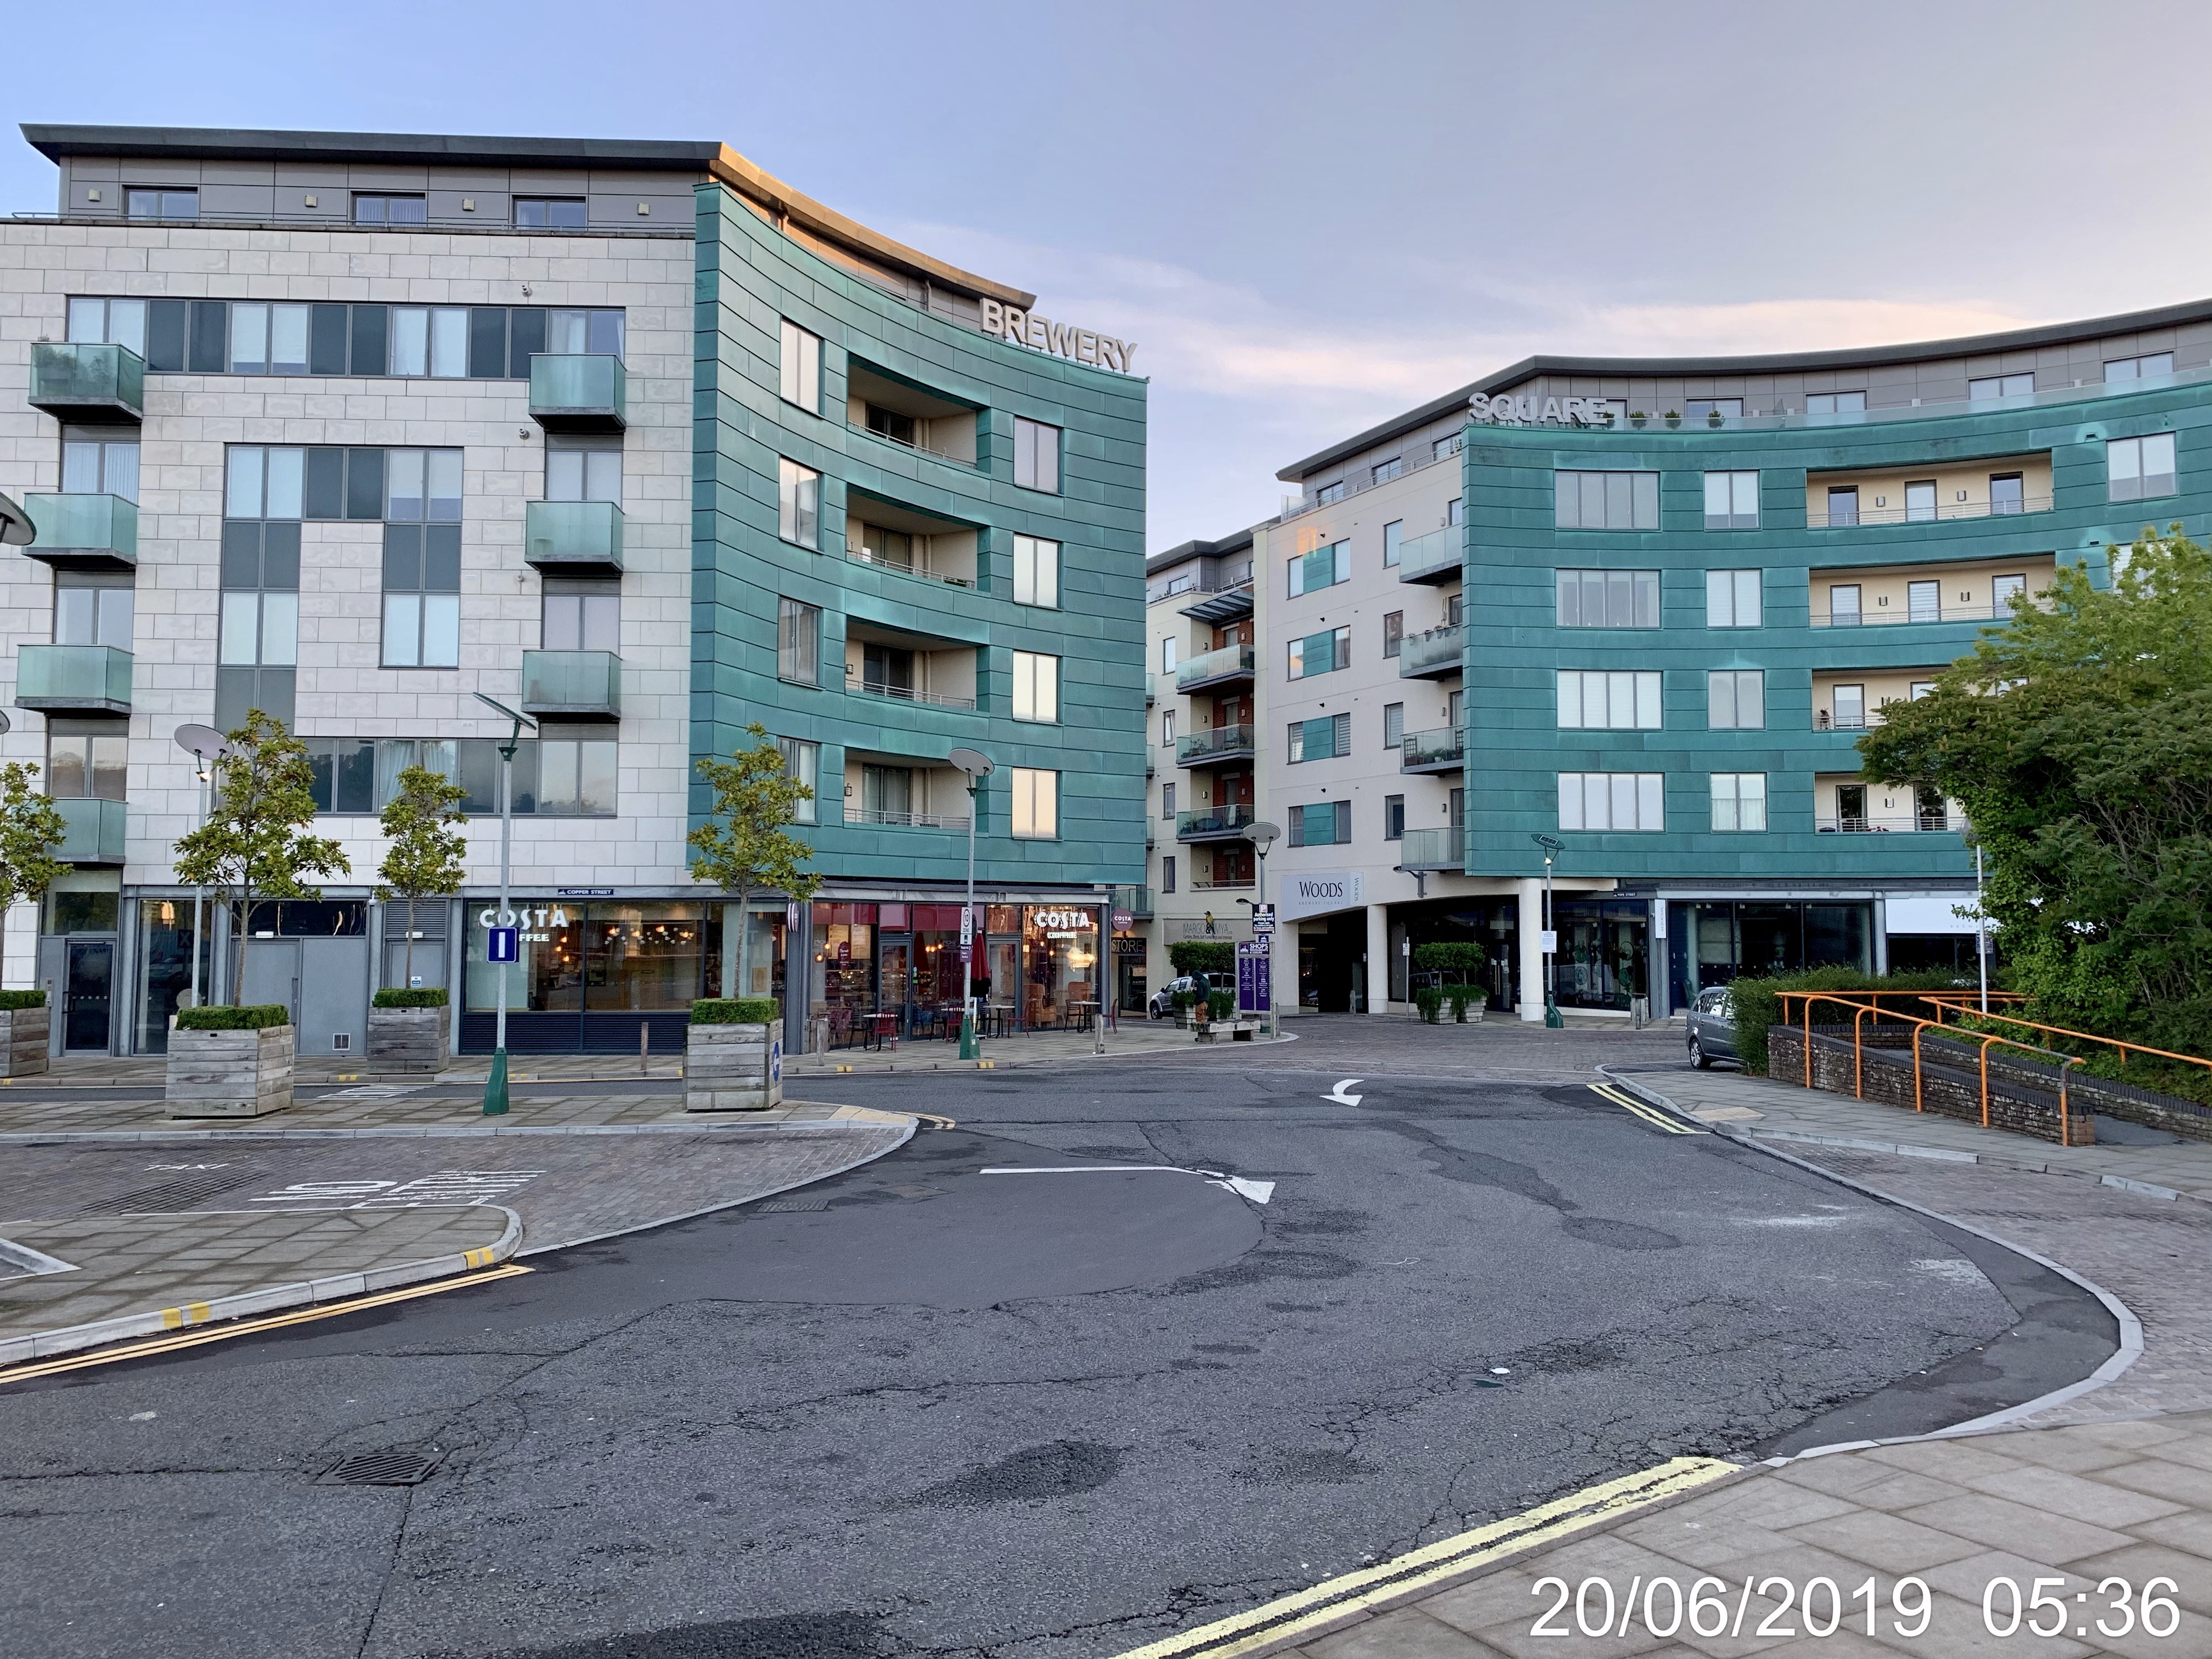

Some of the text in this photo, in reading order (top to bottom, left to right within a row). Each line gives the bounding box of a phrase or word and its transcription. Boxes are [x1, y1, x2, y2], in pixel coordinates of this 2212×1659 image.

[980, 298, 1138, 371] BREWERY
[1469, 392, 1607, 424] SQUARE
[1299, 881, 1342, 898] WOODS
[479, 909, 569, 930] COSTA
[1034, 911, 1090, 929] COSTA
[518, 933, 549, 941] FFEE
[1183, 923, 1205, 933] MARGO
[1206, 923, 1211, 934] &
[1111, 939, 1143, 953] STORE
